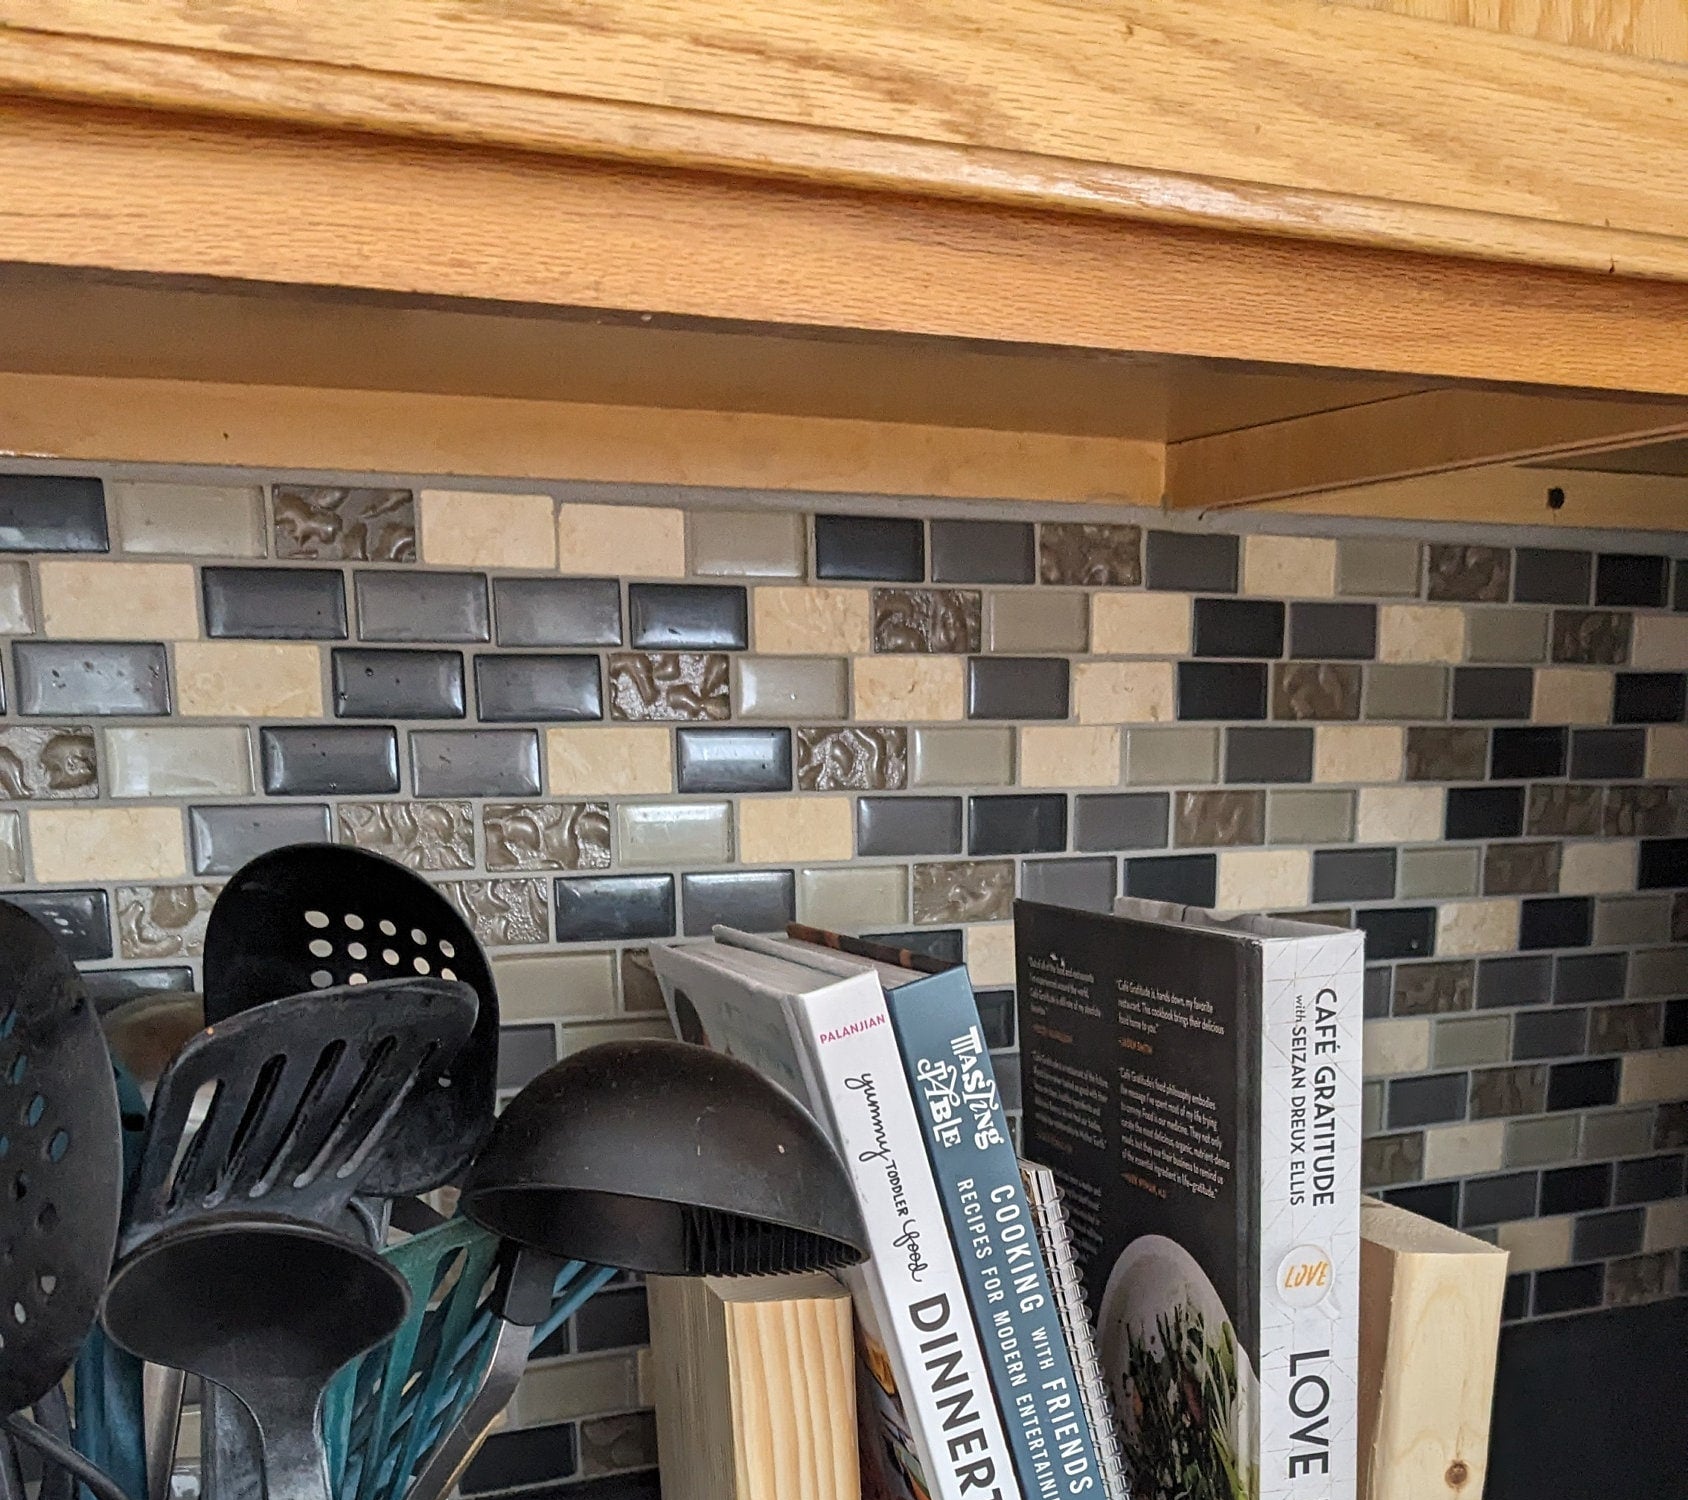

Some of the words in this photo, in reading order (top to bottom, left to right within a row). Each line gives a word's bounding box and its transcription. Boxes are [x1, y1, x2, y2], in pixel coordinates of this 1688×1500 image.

[820, 1014, 886, 1044] PALANJIAN
[1295, 995, 1303, 1025] with
[1314, 988, 1341, 1056] CAFÉ
[1292, 1026, 1307, 1089] SEIZAN
[917, 1059, 961, 1148] TABLE
[1291, 1096, 1306, 1154] DREUX
[1313, 1065, 1337, 1207] GRATITUDE
[845, 1073, 891, 1162] yummy
[885, 1160, 908, 1217] TODDLER
[1290, 1160, 1305, 1206] ELLIS
[957, 1177, 992, 1259] RECIPES
[981, 1266, 1004, 1304] FOR
[993, 1311, 1028, 1387] MODERN
[990, 1184, 1044, 1314] COOKING
[1285, 1260, 1328, 1288] LOVE
[1031, 1326, 1054, 1370] WITH
[1042, 1377, 1093, 1494] FRIENDS
[1288, 1349, 1330, 1479] LOVE
